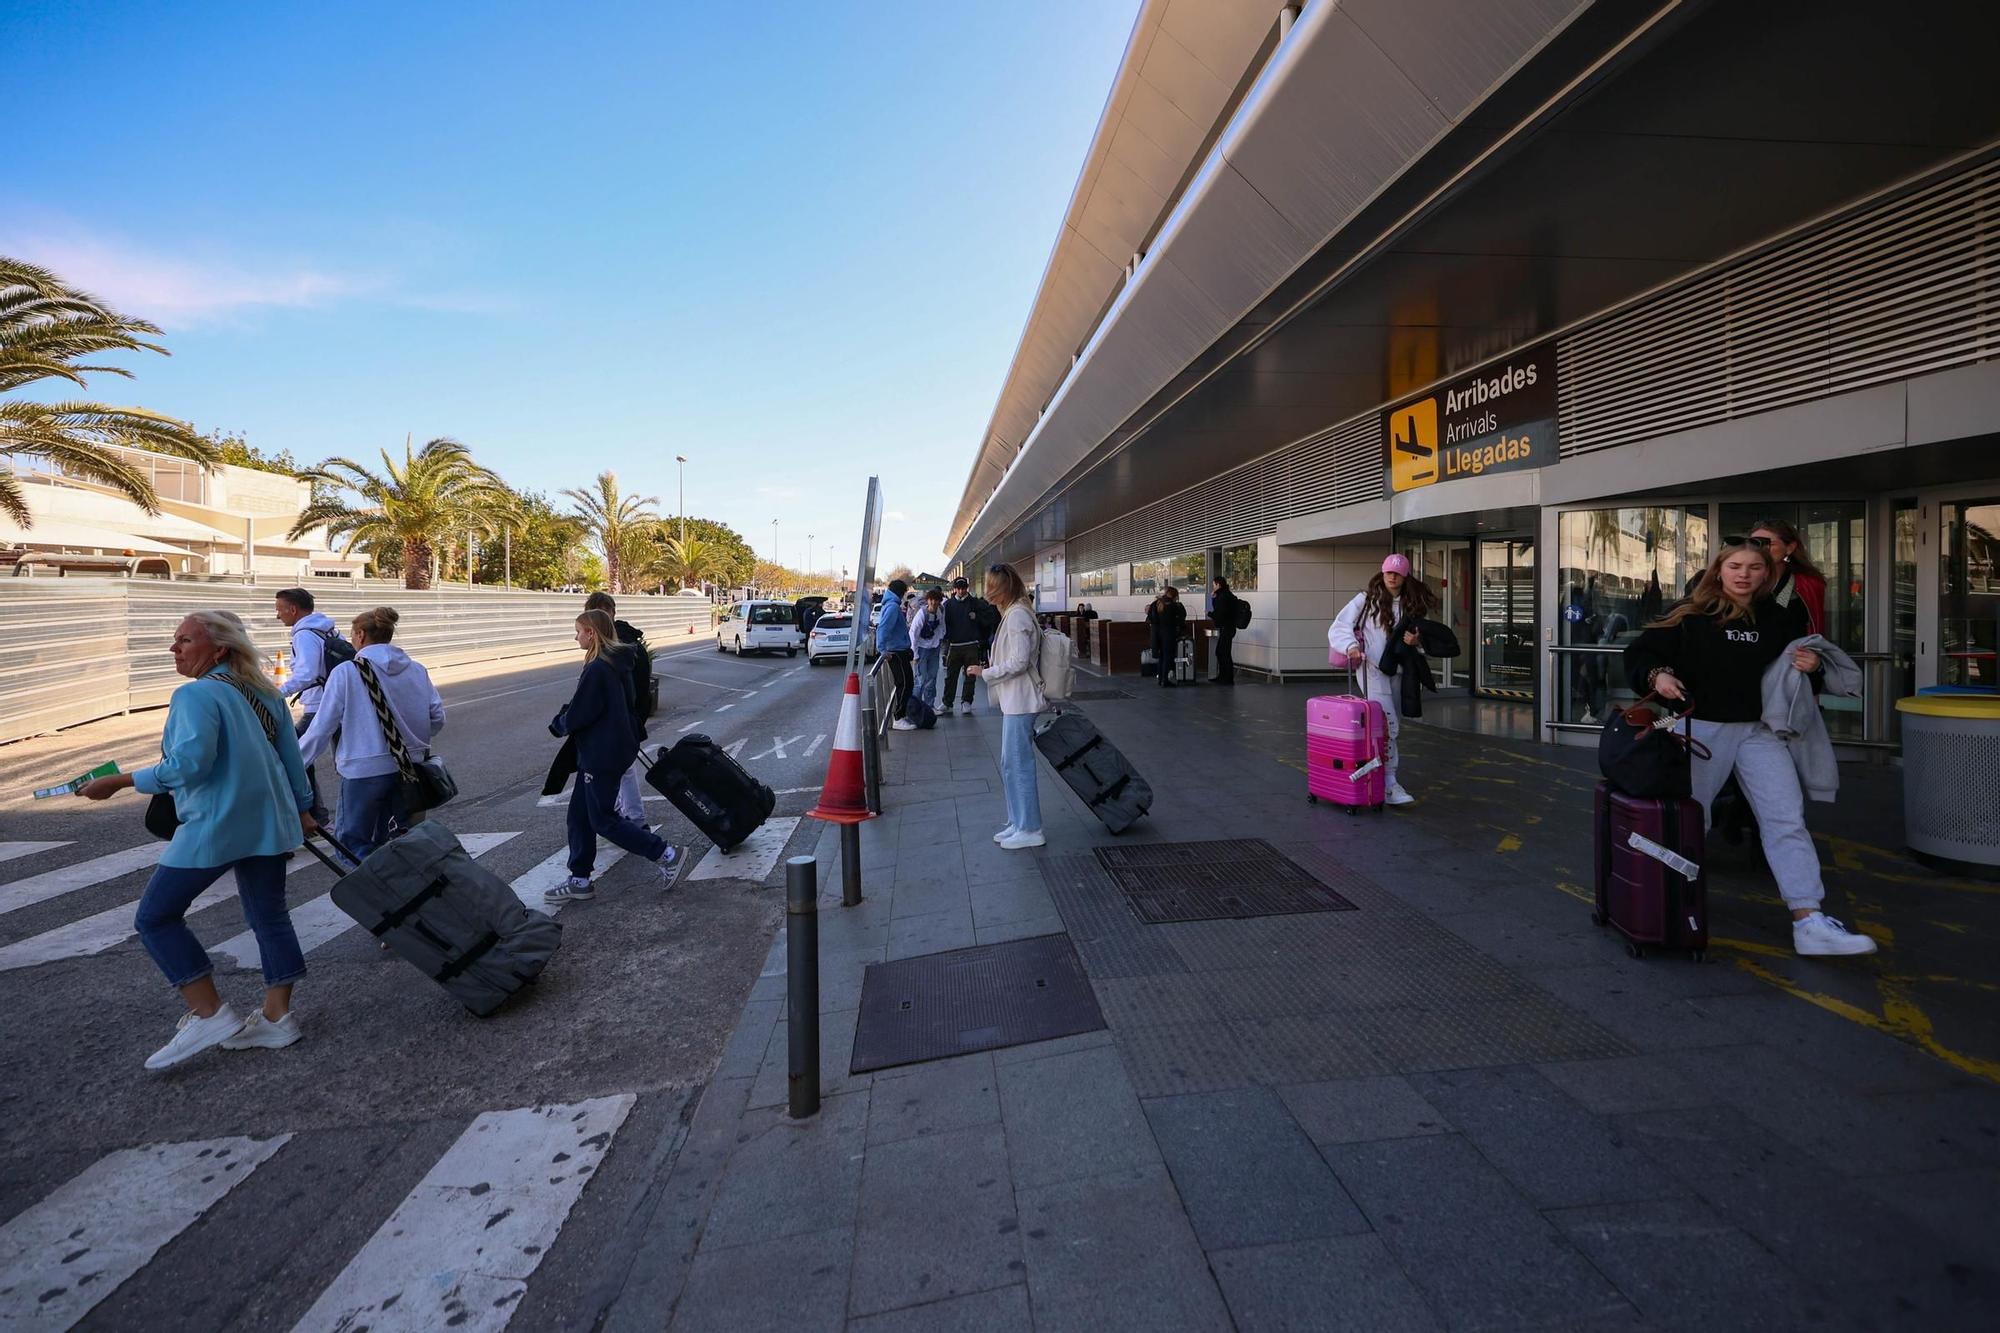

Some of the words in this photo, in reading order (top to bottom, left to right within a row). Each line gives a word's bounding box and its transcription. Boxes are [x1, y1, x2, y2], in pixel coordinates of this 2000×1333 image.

[1446, 363, 1537, 415] Arribades
[1446, 411, 1497, 445] Arrivals
[1446, 434, 1531, 475] Llegadas
[722, 734, 827, 760] AXI
